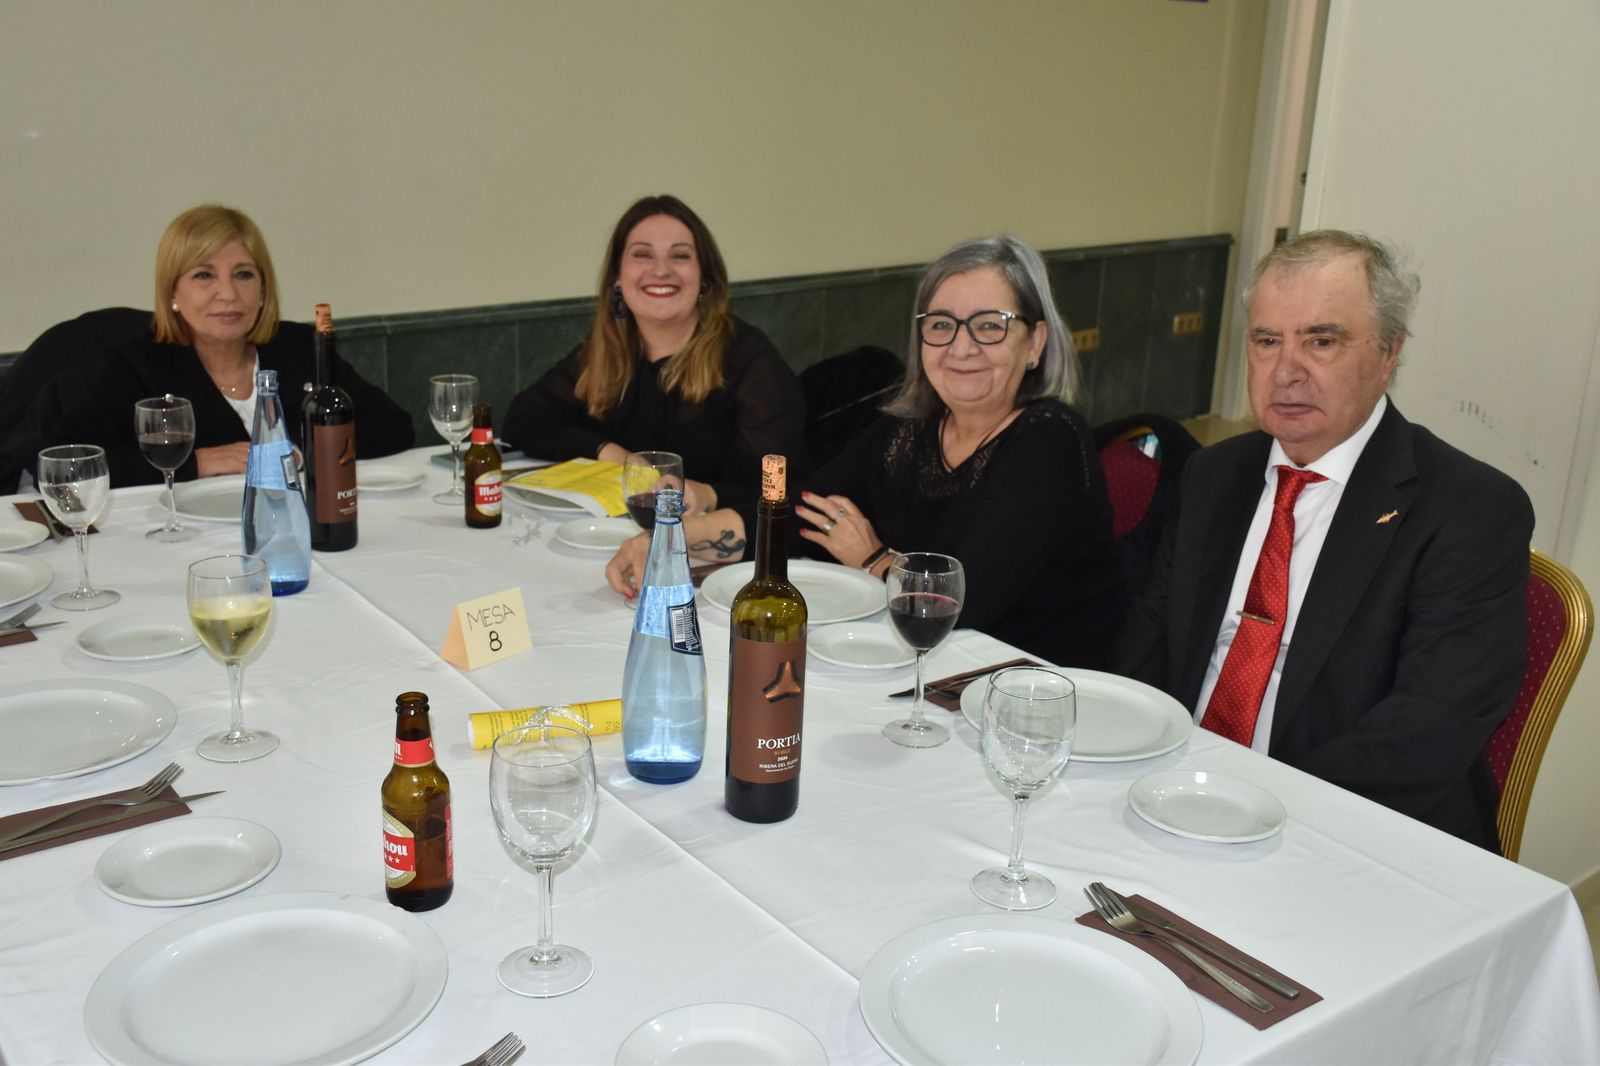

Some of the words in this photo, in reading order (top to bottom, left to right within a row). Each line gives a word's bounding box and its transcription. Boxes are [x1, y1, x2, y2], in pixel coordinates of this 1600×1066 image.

[466, 604, 516, 631] MESA
[489, 630, 503, 652] 8
[757, 733, 800, 749] PORTIA
